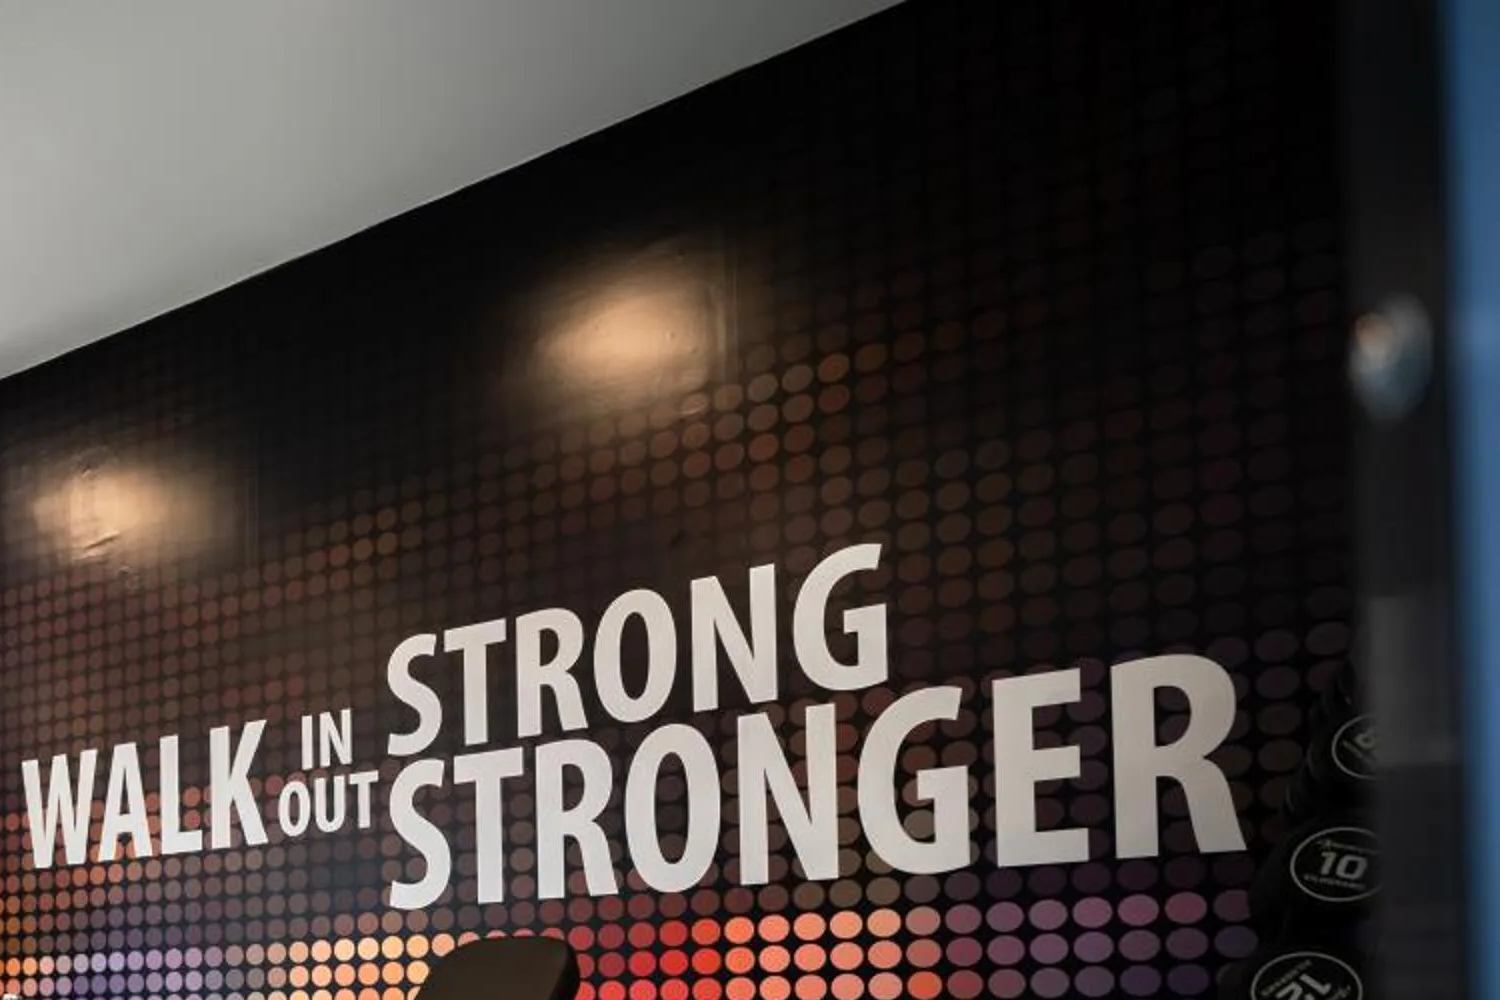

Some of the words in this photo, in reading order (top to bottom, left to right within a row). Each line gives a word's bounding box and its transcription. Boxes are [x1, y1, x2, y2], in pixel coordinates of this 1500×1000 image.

[21, 719, 269, 869] WALK
[300, 708, 353, 771] IN
[386, 543, 888, 757] STRONG
[278, 770, 379, 838] OUT
[389, 653, 1247, 910] STRONGER
[1319, 850, 1369, 881] 10
